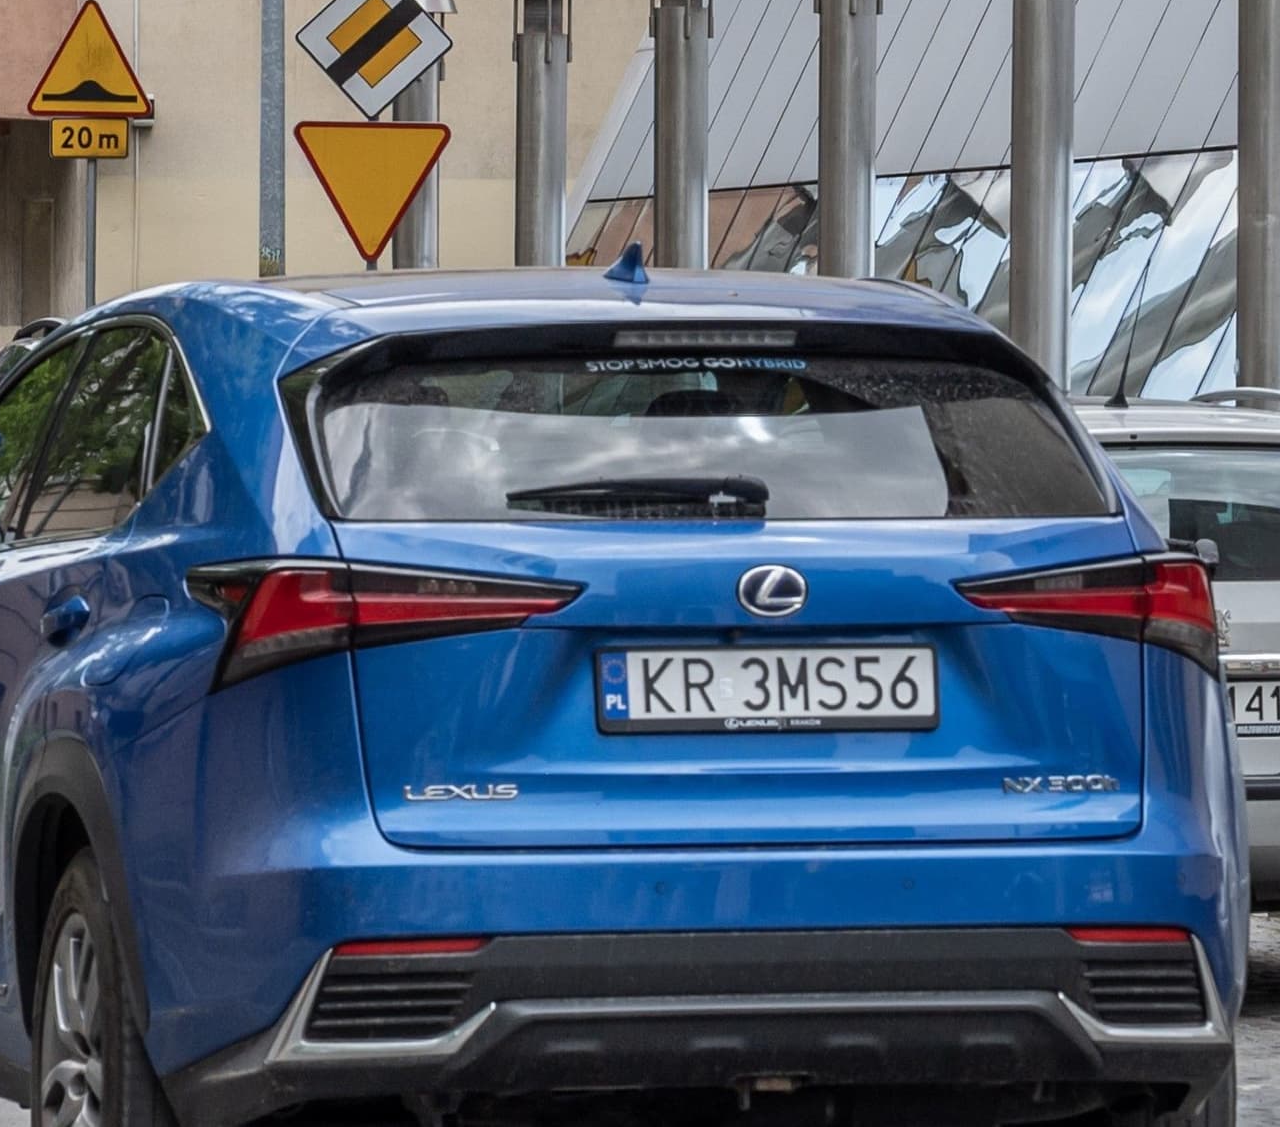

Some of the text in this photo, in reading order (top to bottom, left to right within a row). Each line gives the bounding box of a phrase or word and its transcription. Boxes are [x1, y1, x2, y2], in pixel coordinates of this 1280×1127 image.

[61, 127, 119, 149] 20 m
[641, 655, 920, 713] KR 3MS56
[605, 694, 627, 711] PL
[403, 783, 519, 801] LEXUS
[1002, 776, 1043, 793] NX
